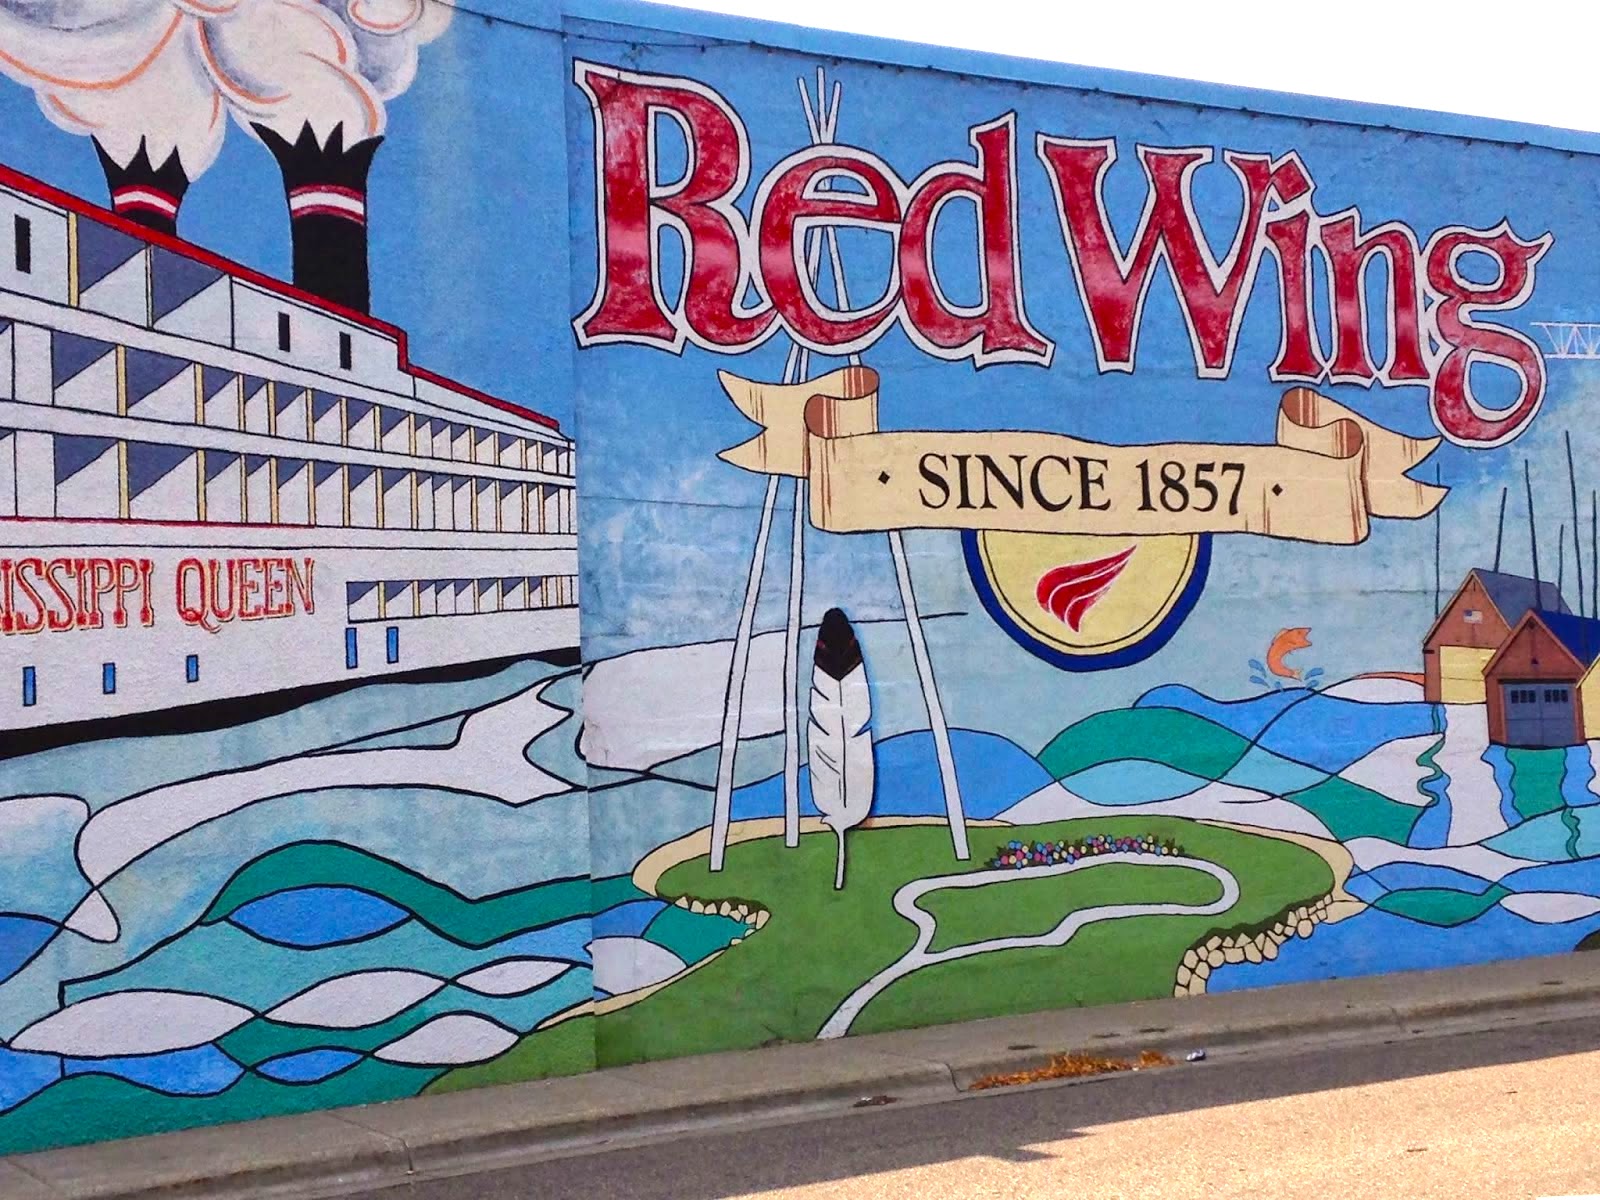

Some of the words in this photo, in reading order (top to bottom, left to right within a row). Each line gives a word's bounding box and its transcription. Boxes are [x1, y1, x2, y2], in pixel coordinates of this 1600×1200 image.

[572, 57, 1055, 371] Red
[1036, 132, 1554, 449] Wing
[918, 453, 1111, 511] SINCE
[1136, 460, 1246, 515] 1857
[176, 557, 314, 633] QUEEN
